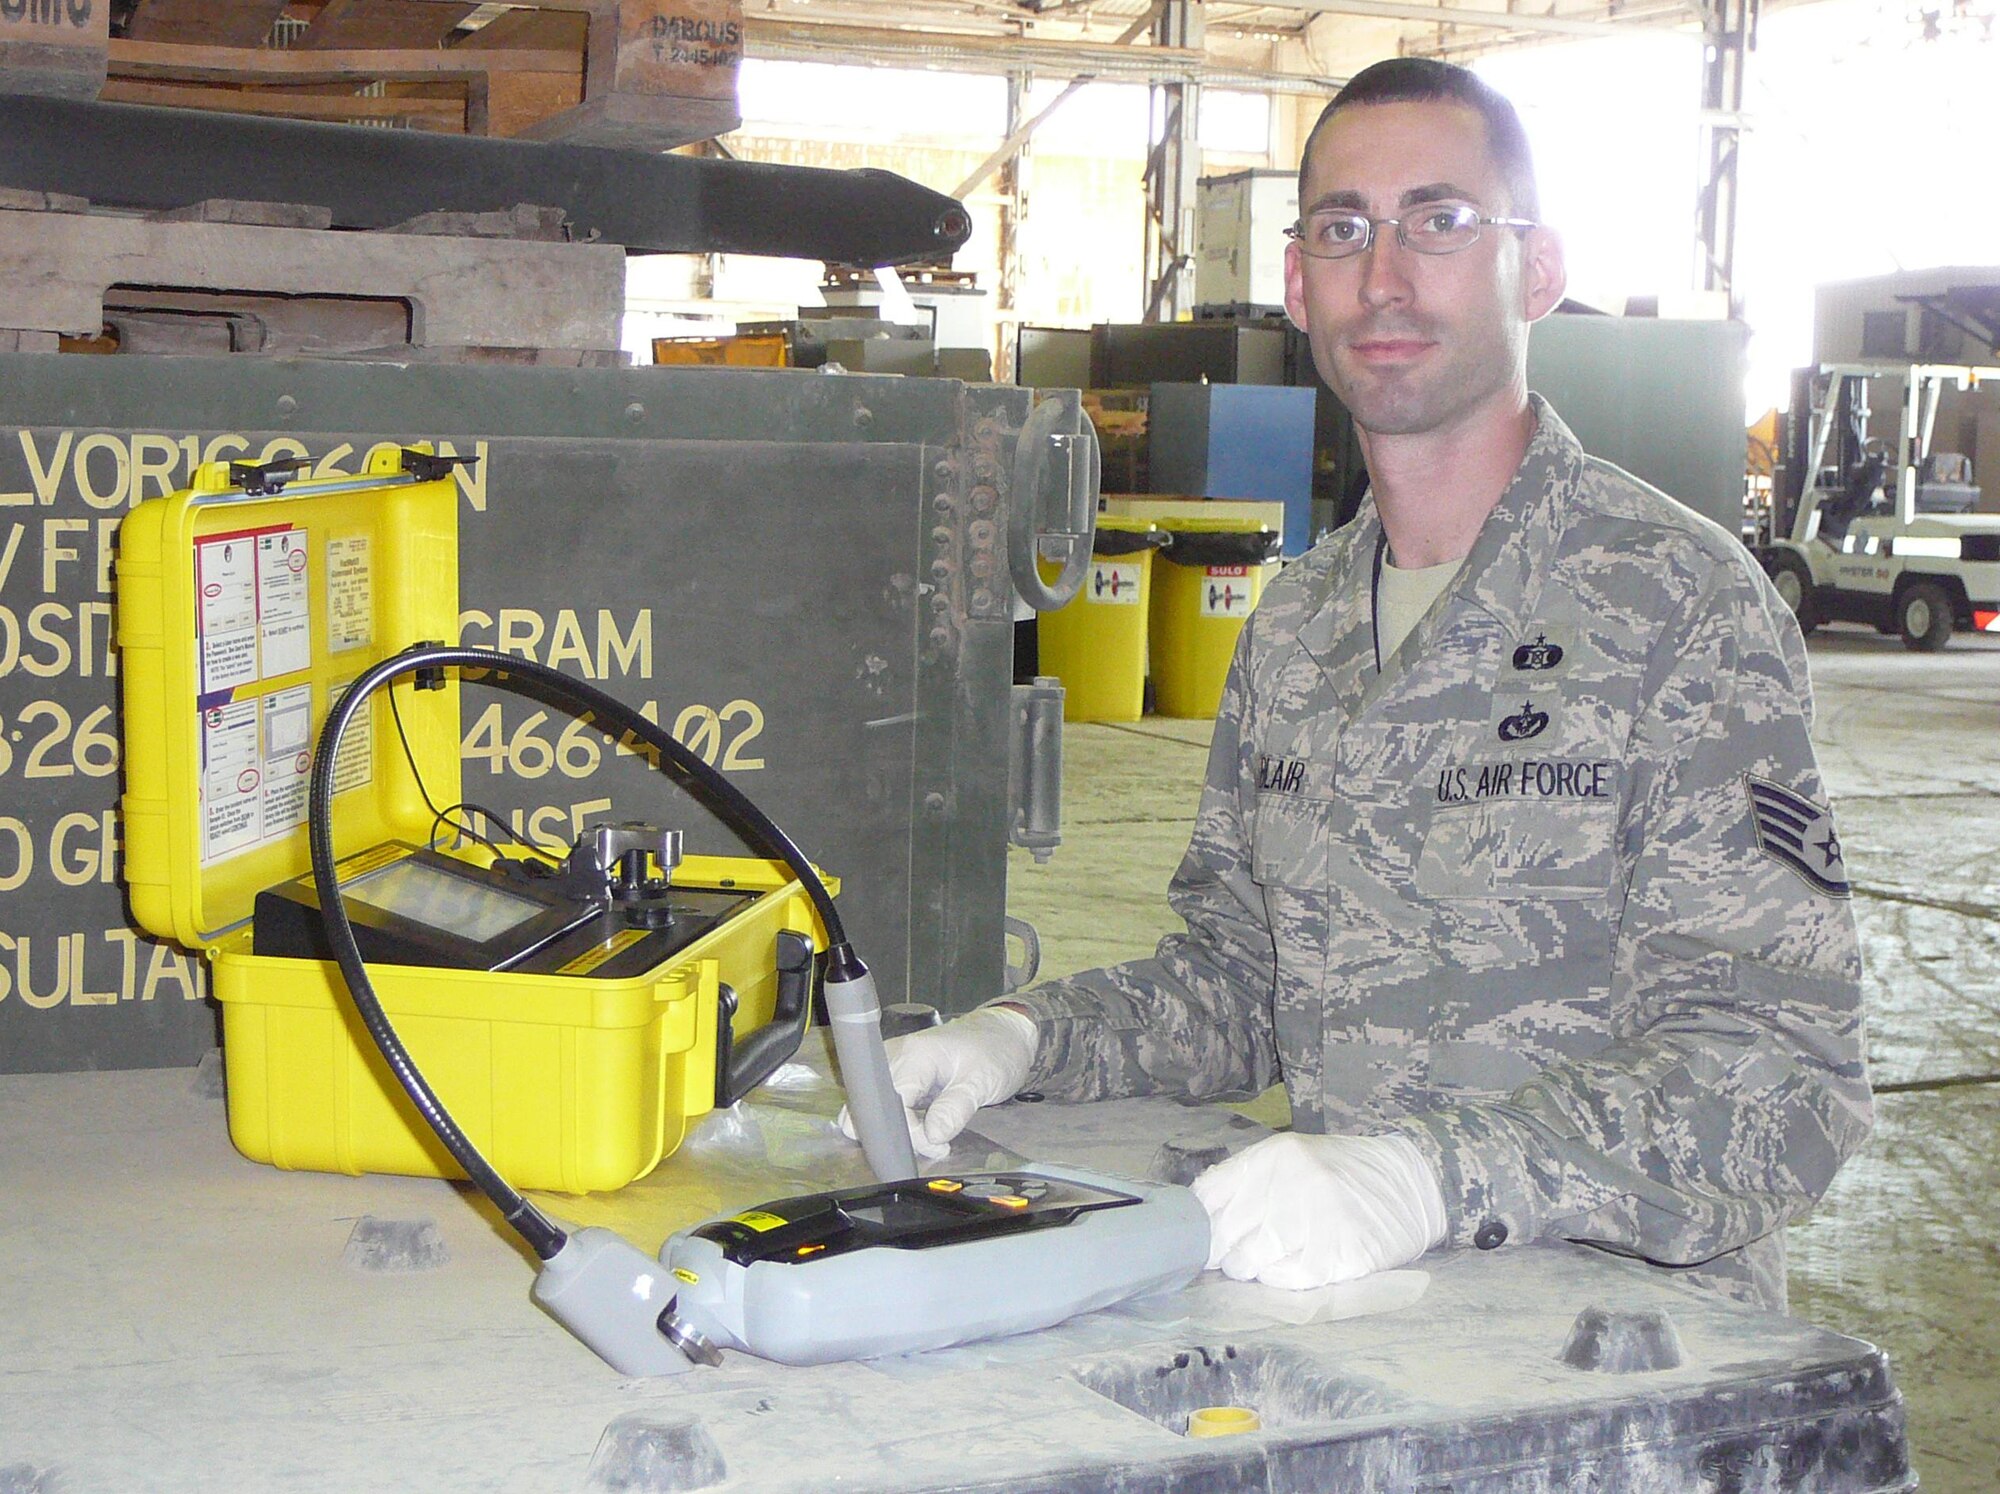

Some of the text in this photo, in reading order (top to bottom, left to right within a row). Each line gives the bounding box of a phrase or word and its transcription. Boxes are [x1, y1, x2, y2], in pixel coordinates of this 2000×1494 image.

[1210, 566, 1243, 576] SULO
[1438, 769, 1468, 801] U.S.
[1475, 763, 1513, 798] AIR
[1521, 762, 1609, 798] FORCE
[0, 928, 206, 1010] ULTA
